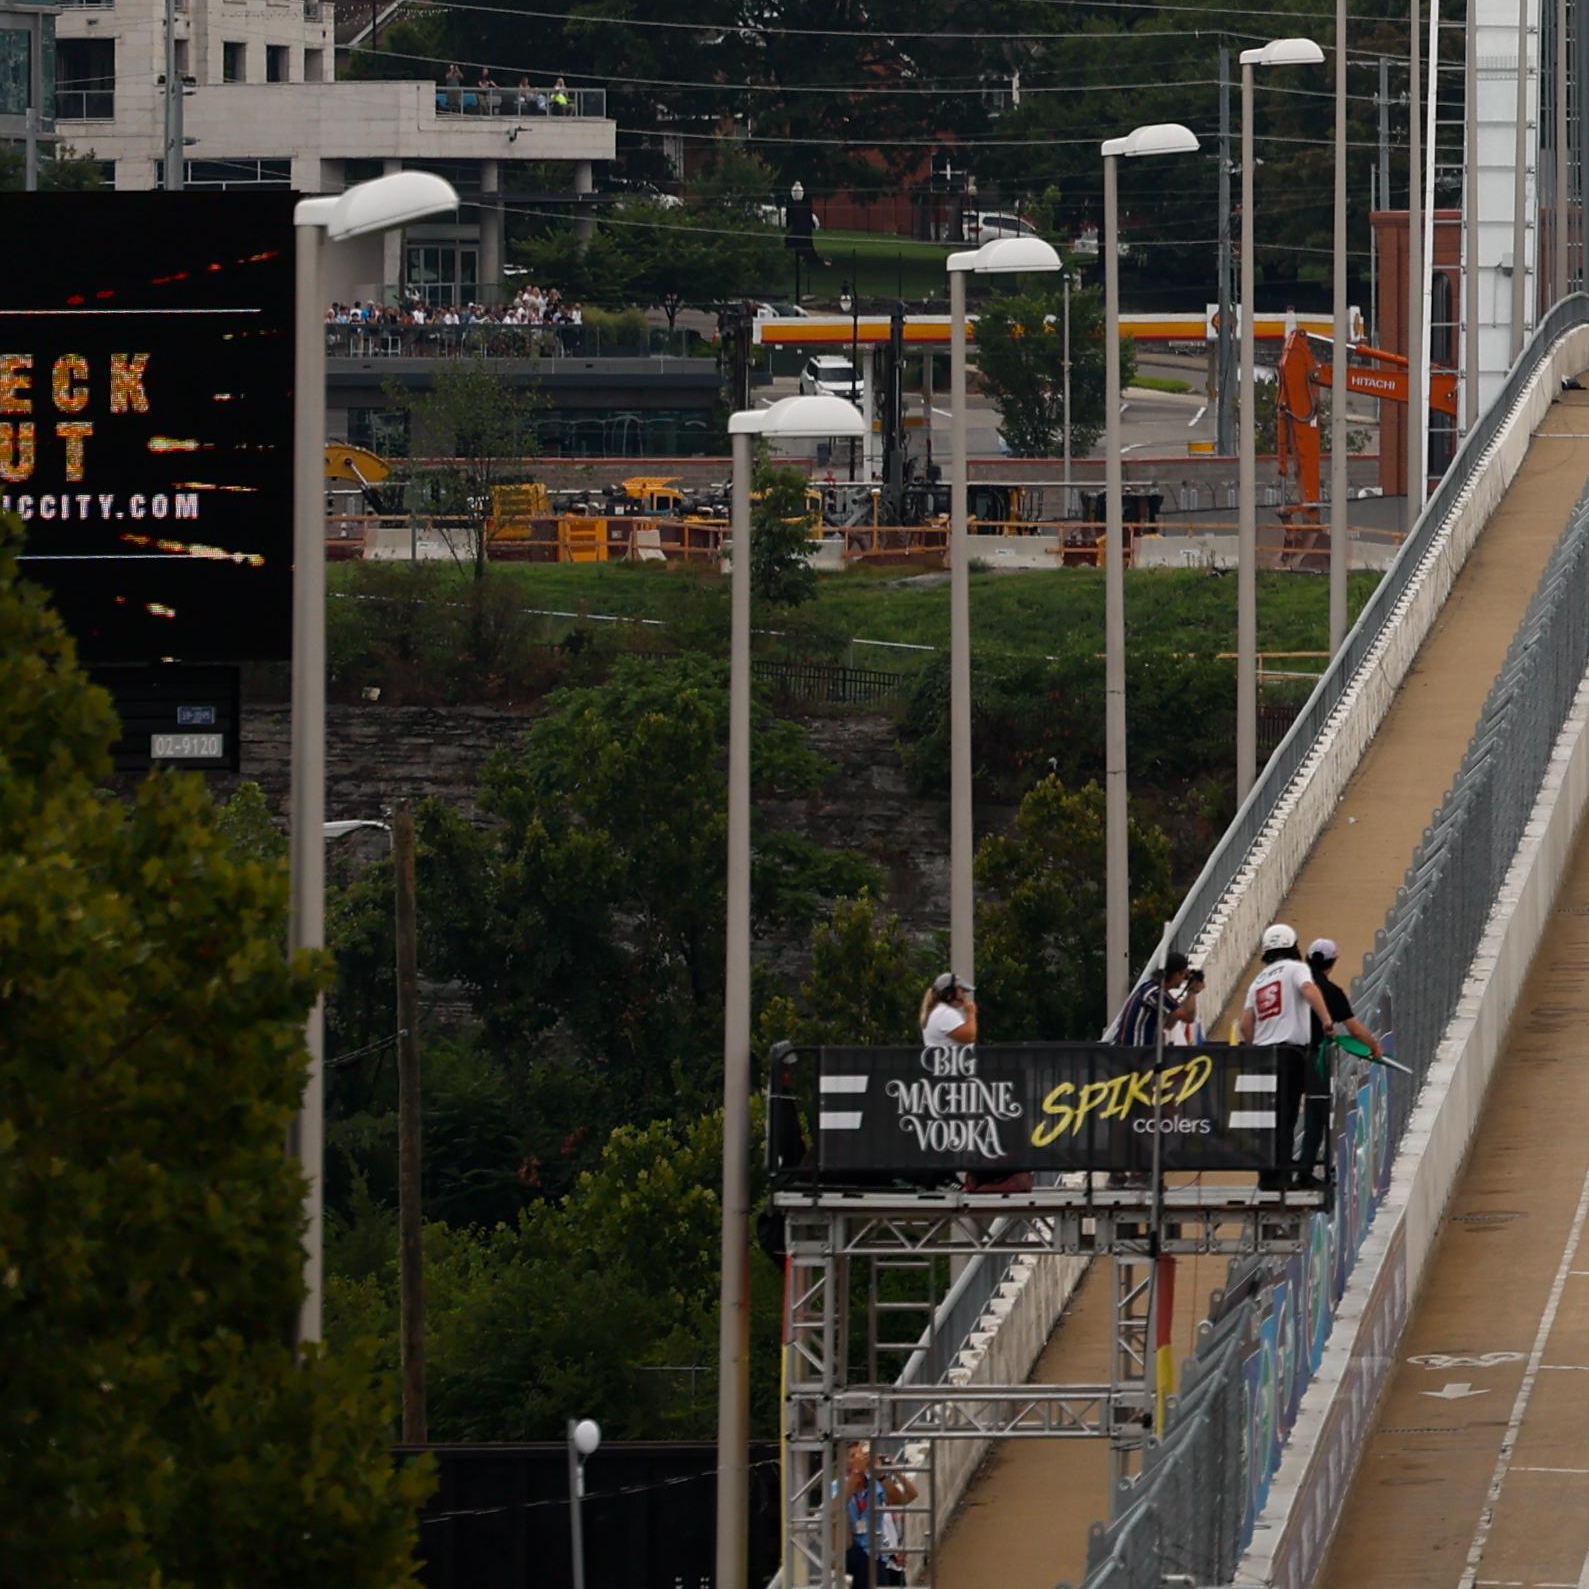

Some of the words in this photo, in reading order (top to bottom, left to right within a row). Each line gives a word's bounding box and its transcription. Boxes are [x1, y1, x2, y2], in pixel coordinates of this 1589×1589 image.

[1351, 376, 1396, 390] HITACHI
[155, 736, 218, 756] 02-9120
[921, 1045, 977, 1077] BIG
[885, 1079, 1024, 1121] MACHINE
[1031, 1055, 1213, 1148] SPIKED
[899, 1115, 1008, 1159] VODKA
[1133, 1113, 1212, 1134] coolers
